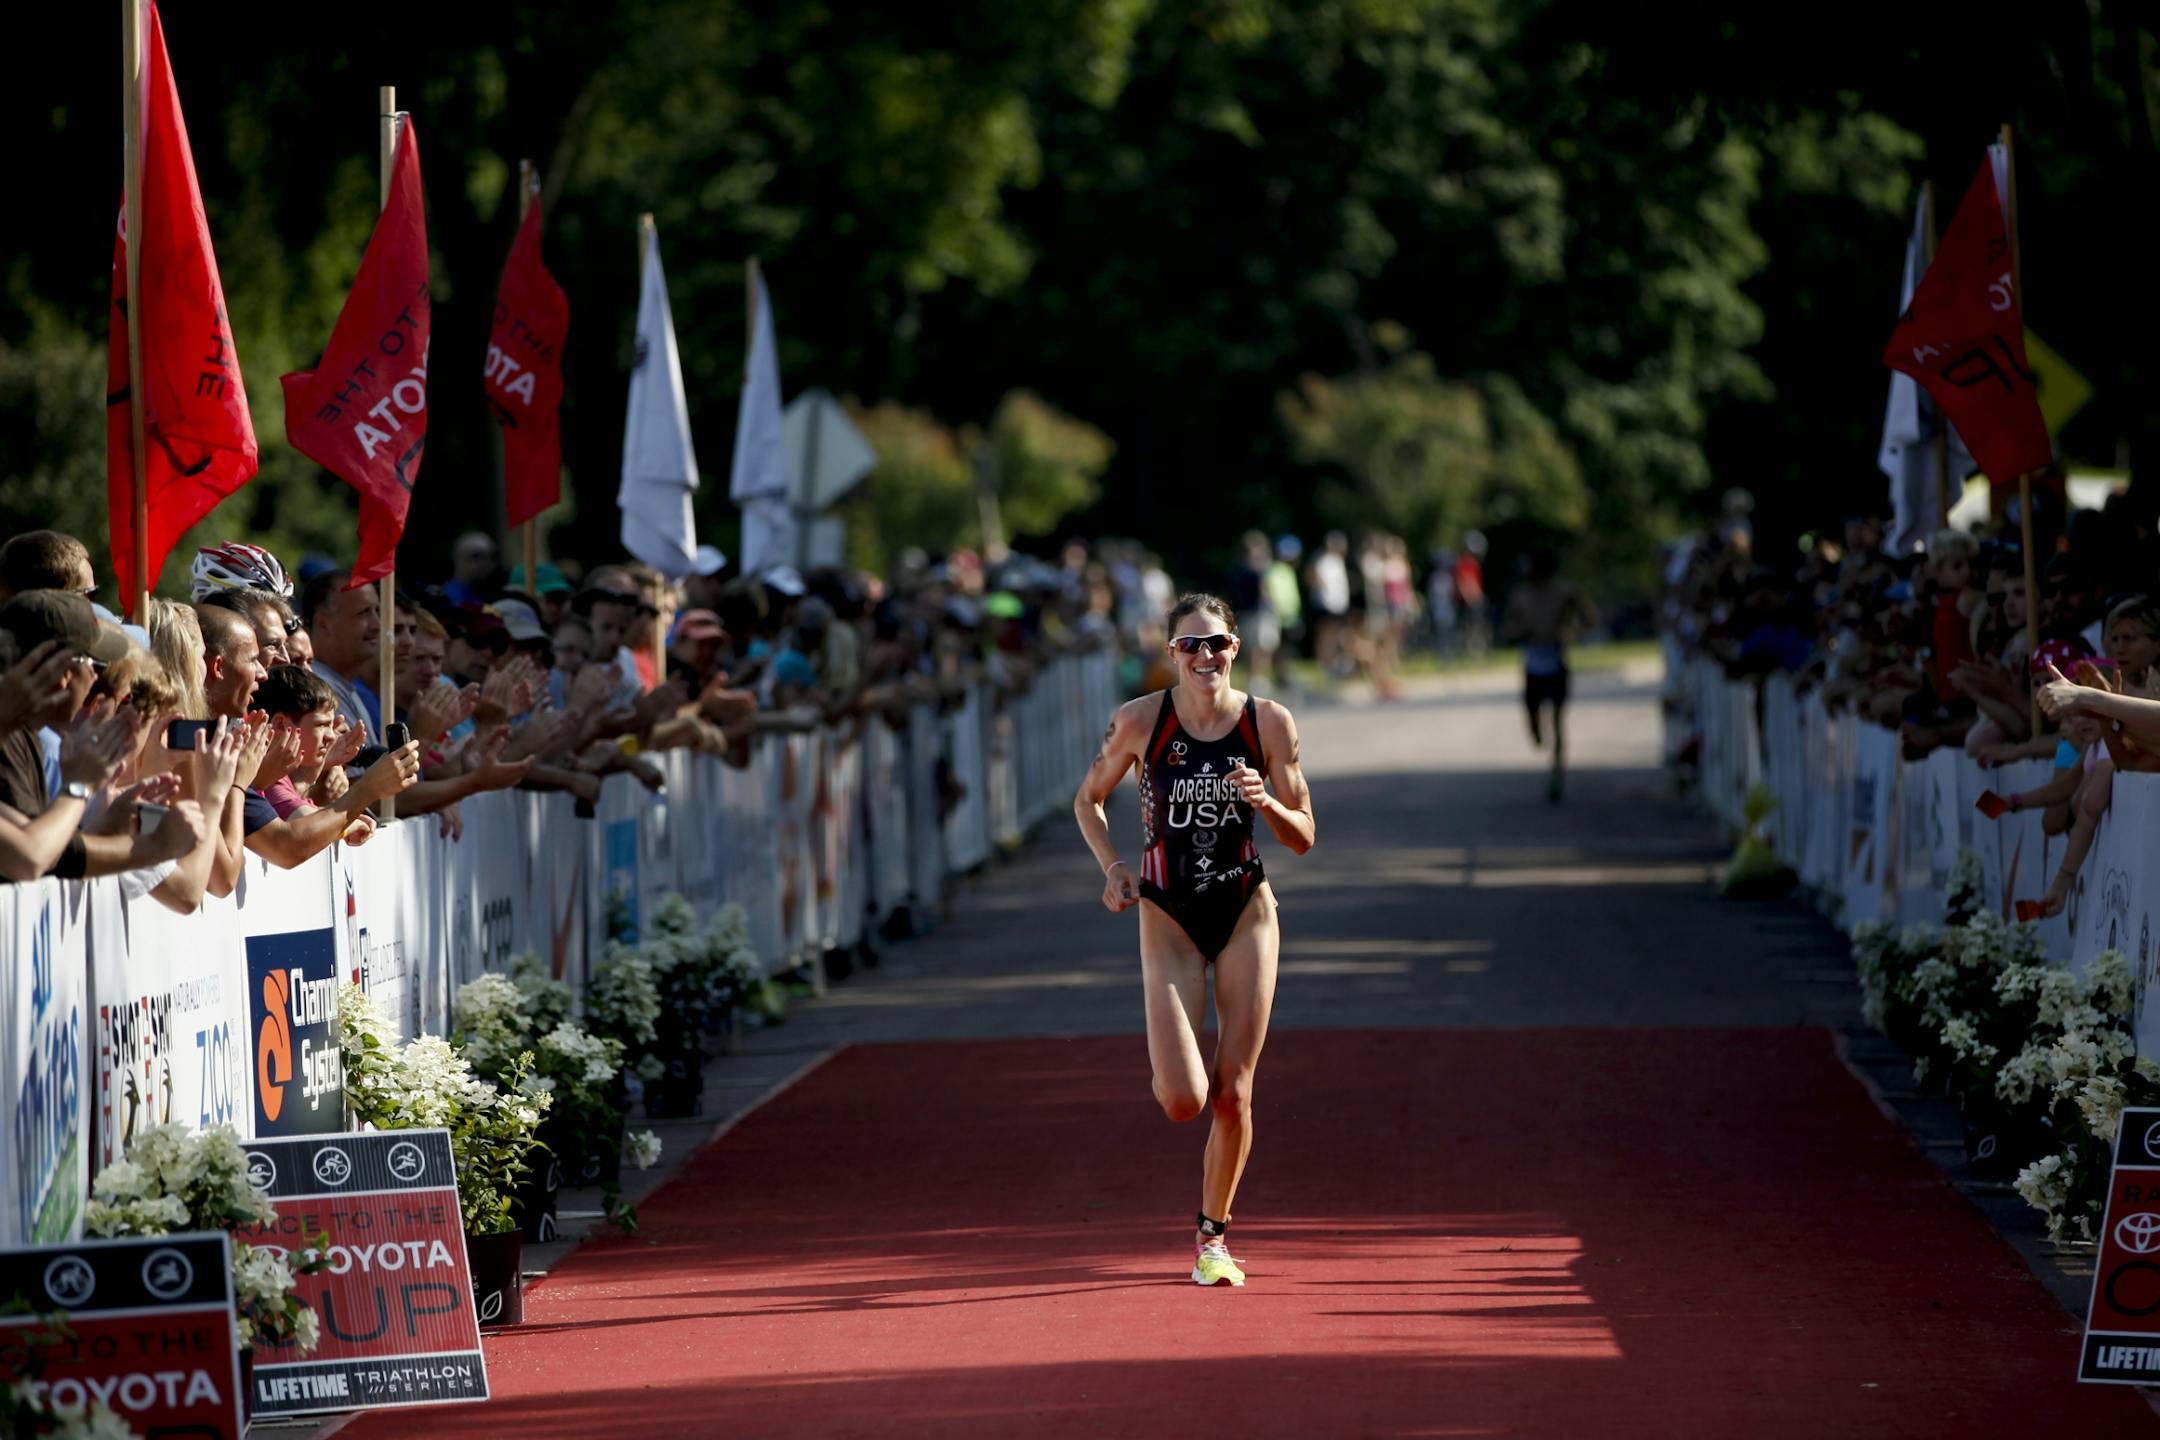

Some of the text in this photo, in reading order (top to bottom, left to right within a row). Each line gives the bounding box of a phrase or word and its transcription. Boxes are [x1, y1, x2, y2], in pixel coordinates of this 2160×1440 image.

[1168, 802, 1243, 828] USA
[111, 1000, 141, 1069] SHOT
[151, 993, 173, 1058] SHOT
[196, 1021, 234, 1132] ZICO
[330, 1211, 373, 1231] TO
[384, 1205, 447, 1228] THE
[353, 1365, 472, 1386] TRIATHLON
